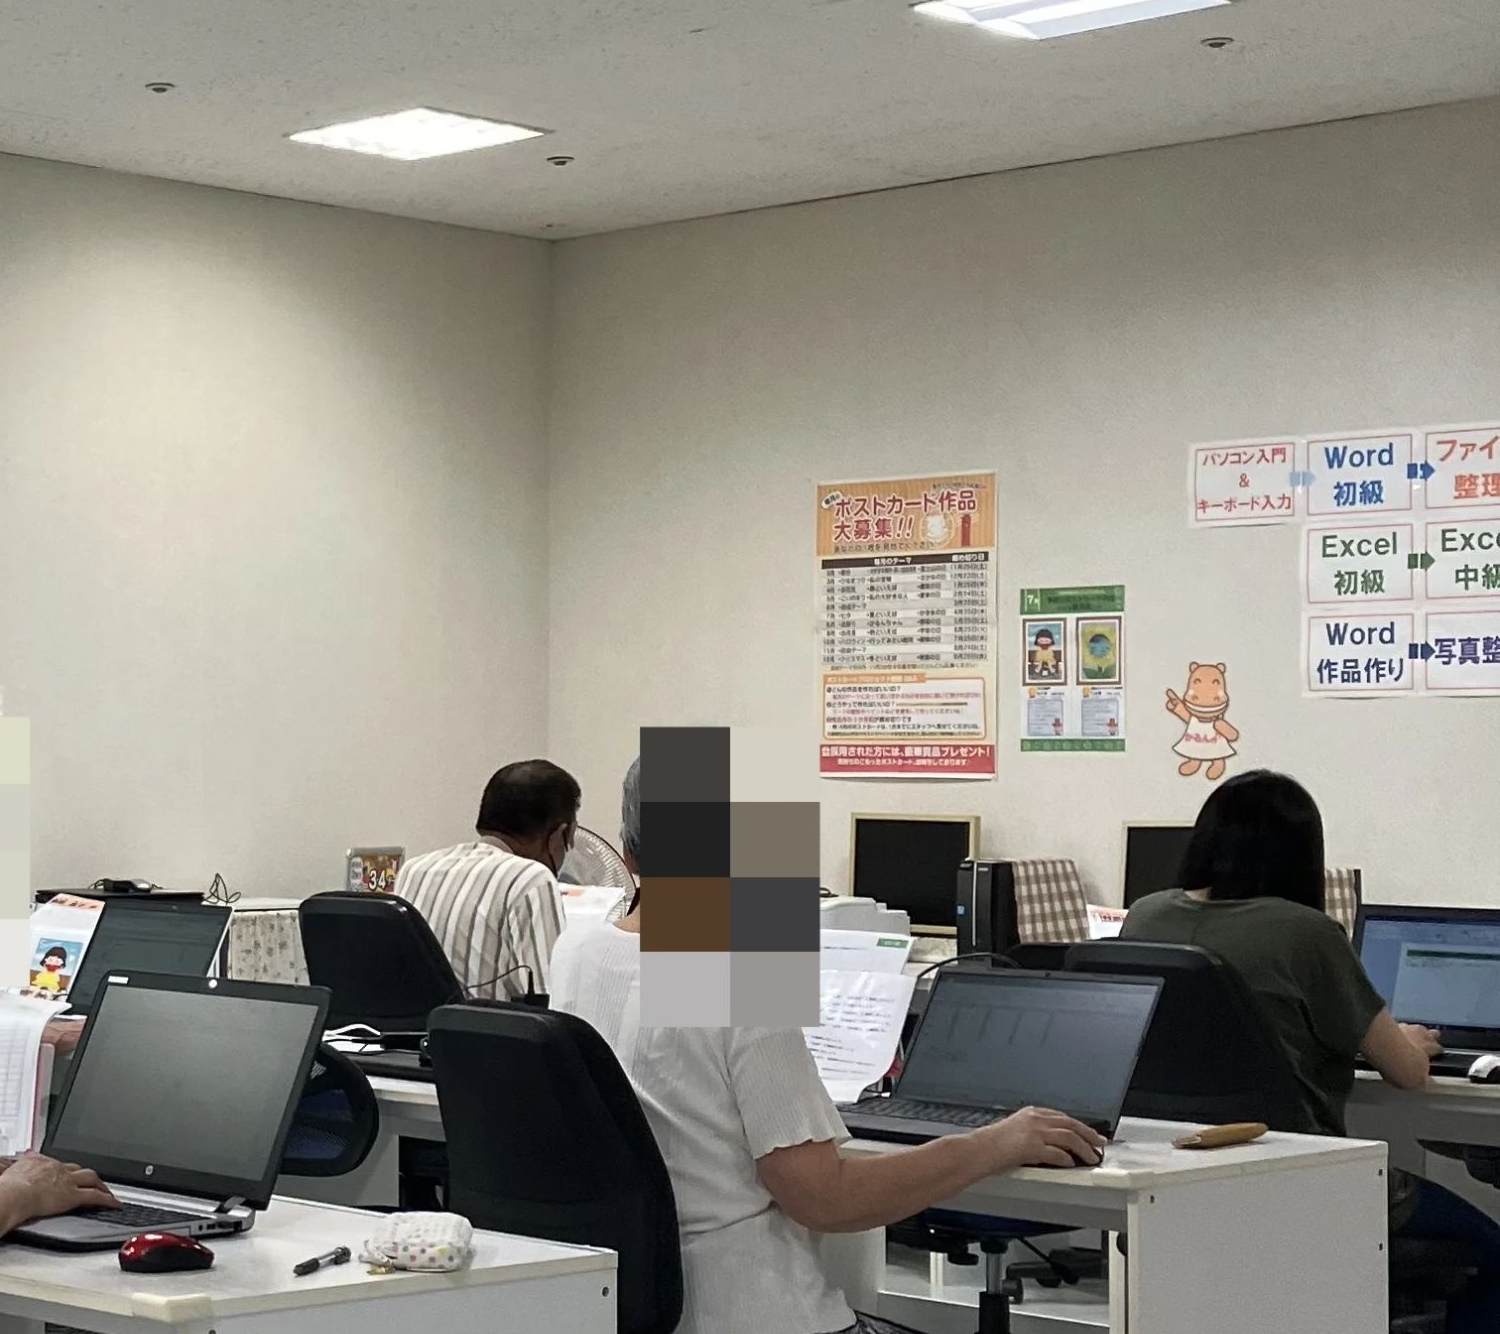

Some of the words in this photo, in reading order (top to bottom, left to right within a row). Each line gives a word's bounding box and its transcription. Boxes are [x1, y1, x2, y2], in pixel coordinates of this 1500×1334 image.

[1202, 447, 1287, 466] パソコン入門
[1324, 442, 1394, 470] Word
[1239, 473, 1250, 488] &
[1333, 479, 1385, 508] 初級
[834, 489, 977, 518] ポストカード作品
[1197, 493, 1292, 514] キーボード入力
[1322, 532, 1398, 558] Excel
[1440, 528, 1500, 552] Exc
[1333, 569, 1385, 596] 初級
[1455, 564, 1500, 591] 中級
[1325, 621, 1395, 646] Word
[1316, 657, 1404, 684] 作品作り
[369, 869, 387, 891] 34
